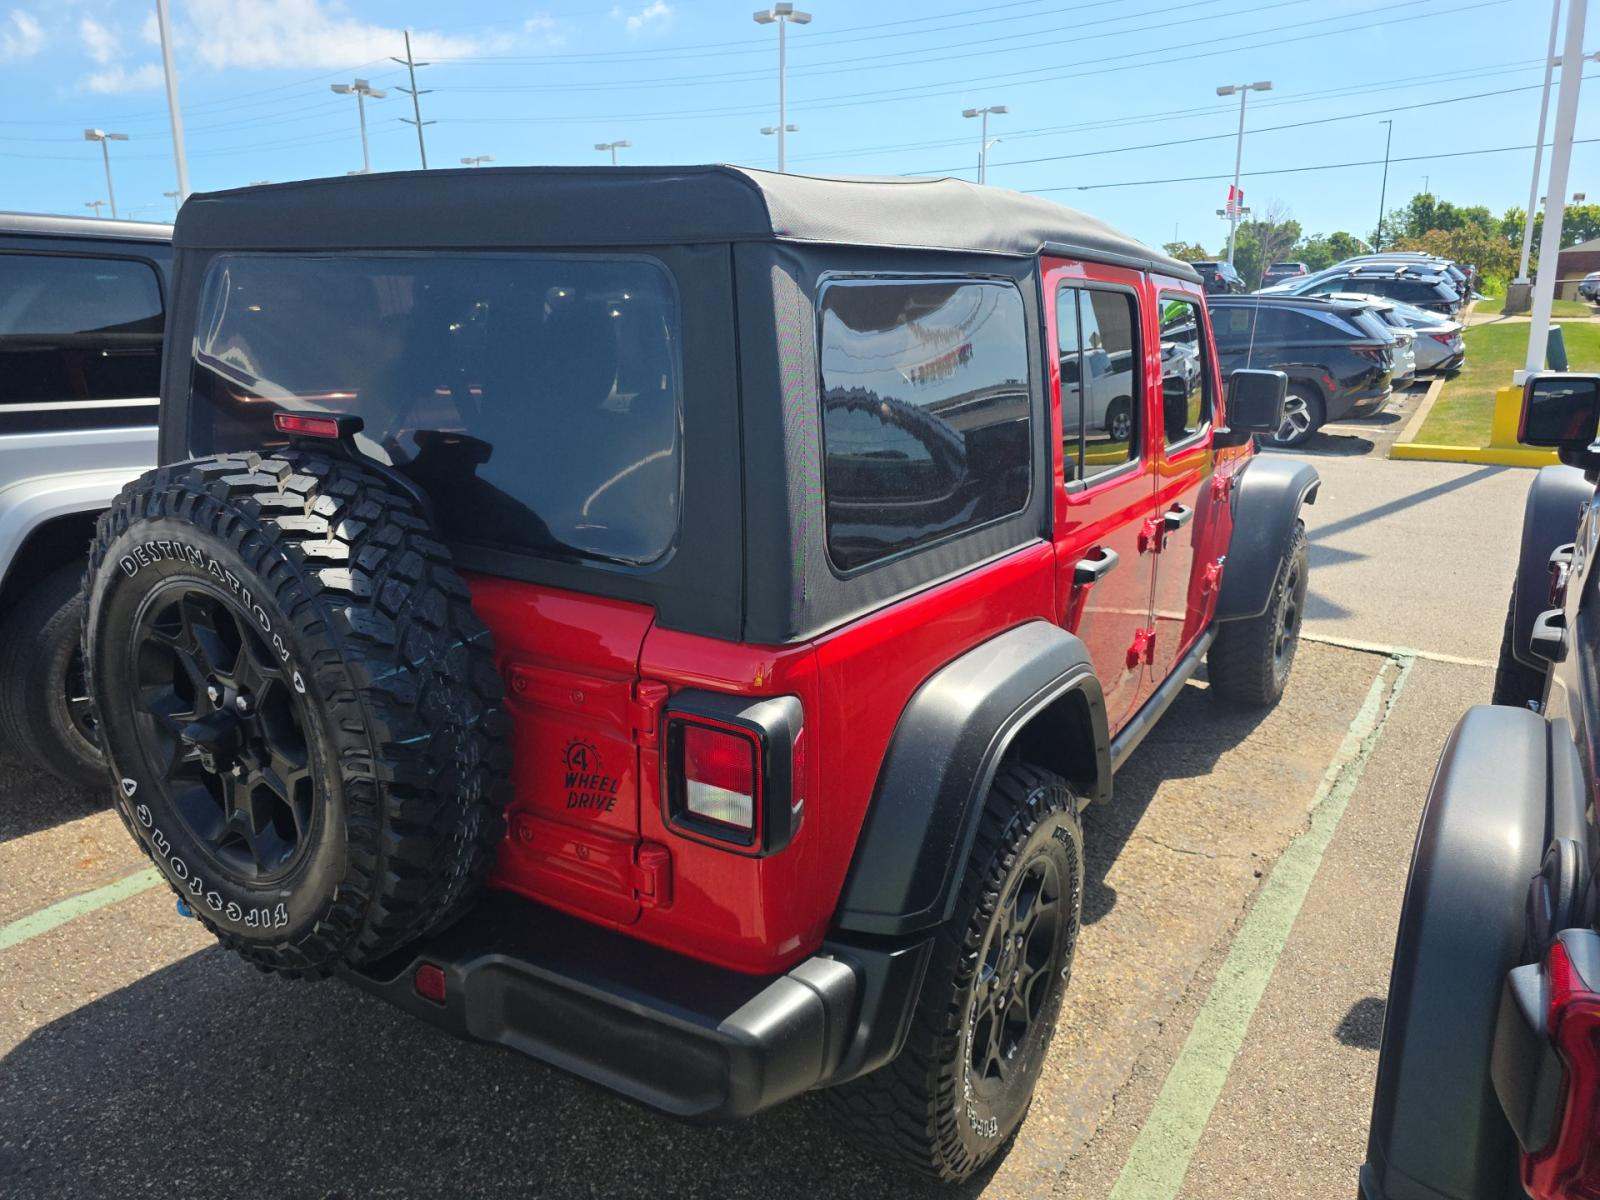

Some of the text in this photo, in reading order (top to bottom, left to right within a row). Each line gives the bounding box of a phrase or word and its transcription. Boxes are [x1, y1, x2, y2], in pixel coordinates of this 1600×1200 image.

[119, 541, 290, 662] DESTINATION
[572, 748, 588, 771] 4
[564, 772, 618, 794] WHEEL
[566, 791, 617, 813] DRIVE
